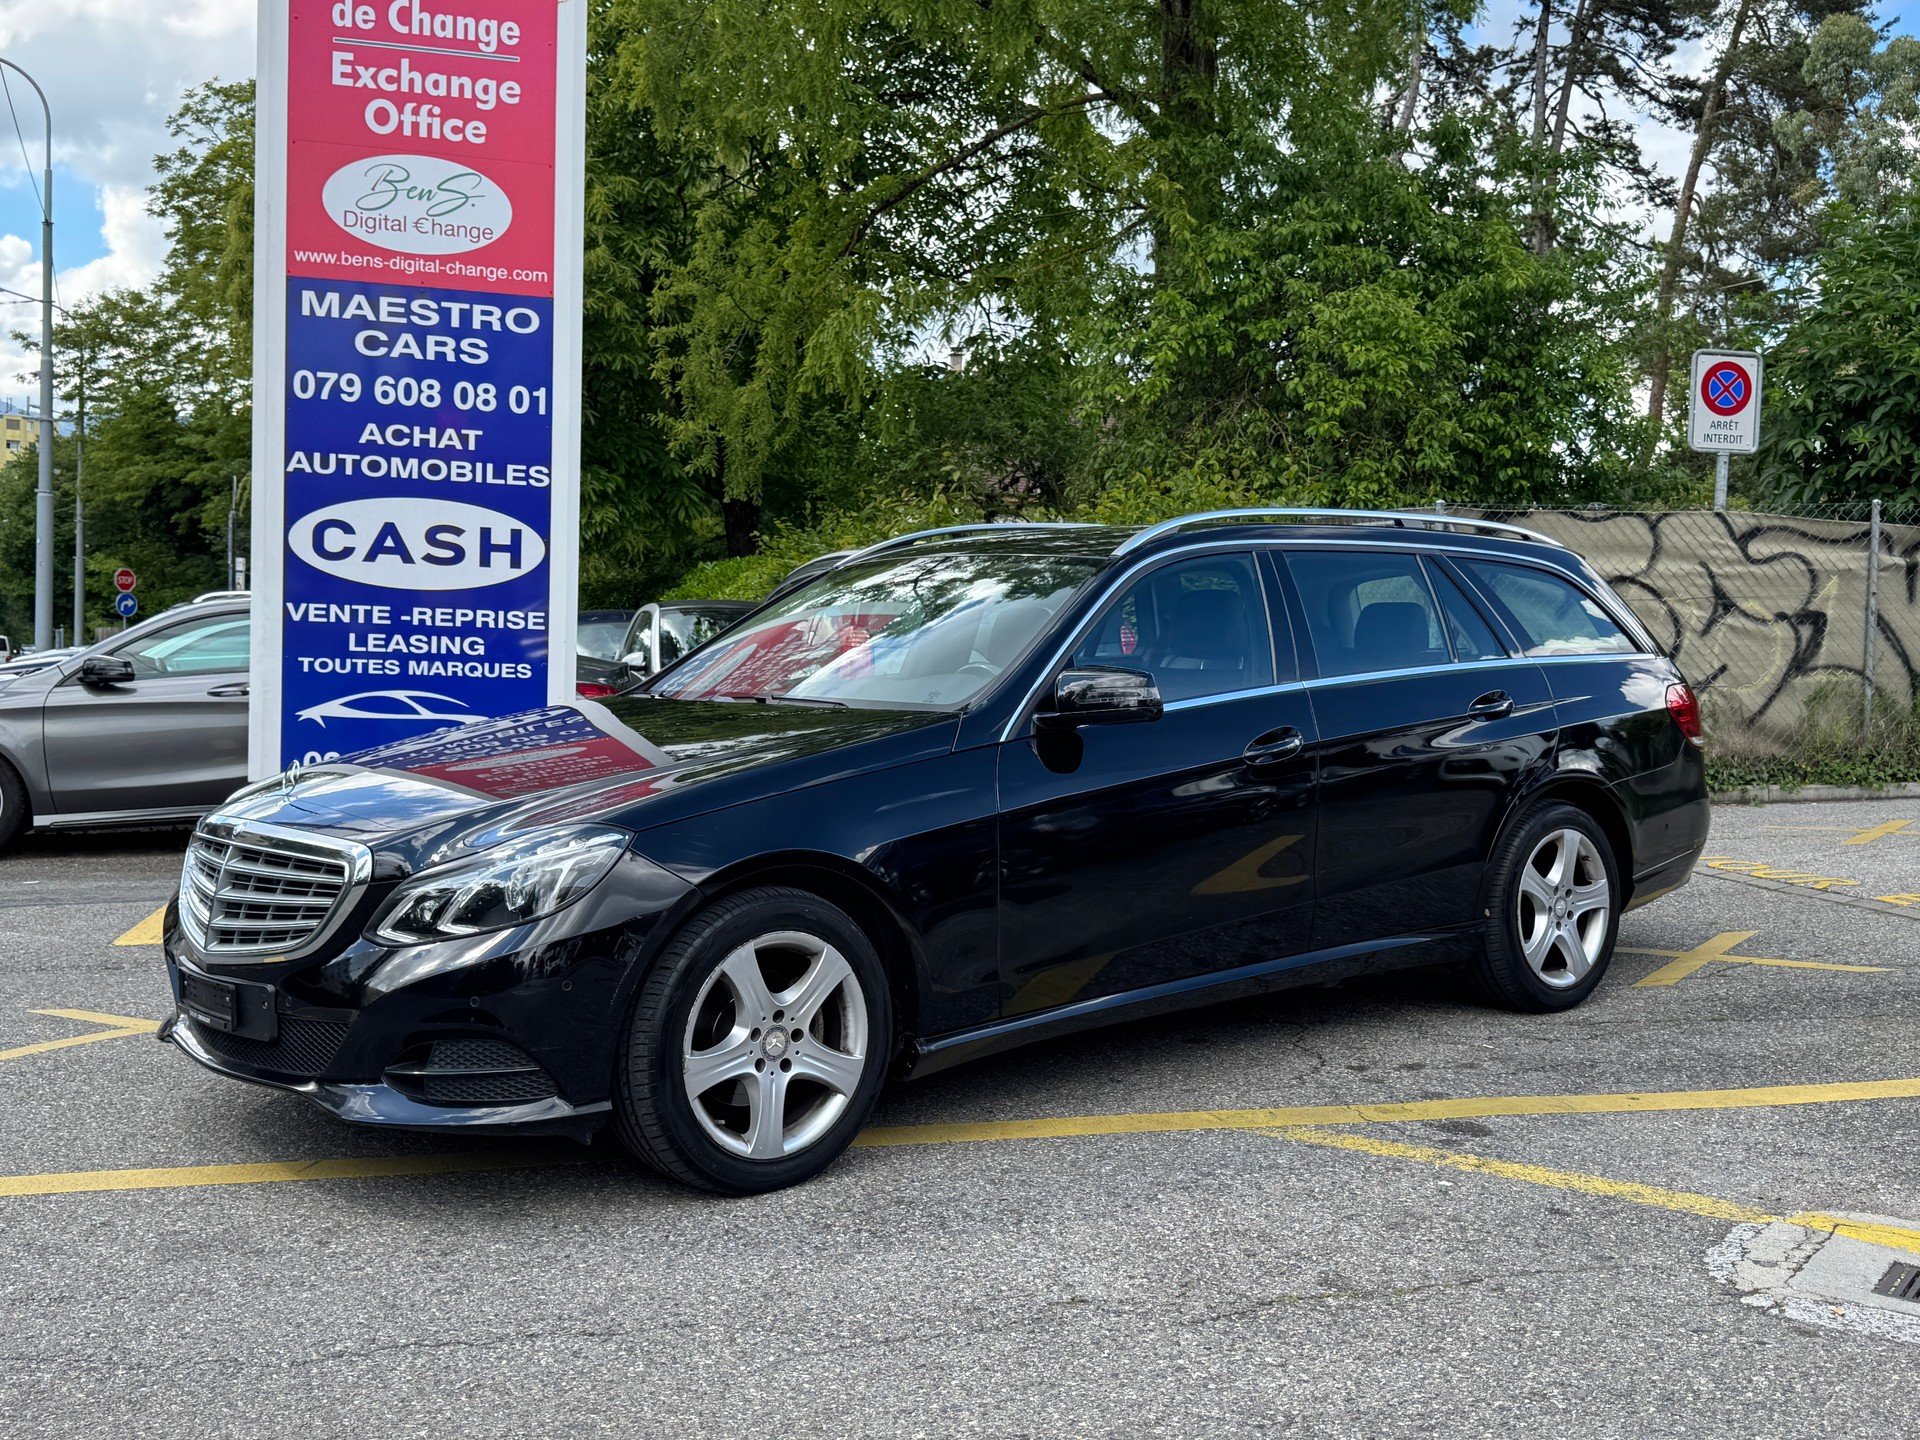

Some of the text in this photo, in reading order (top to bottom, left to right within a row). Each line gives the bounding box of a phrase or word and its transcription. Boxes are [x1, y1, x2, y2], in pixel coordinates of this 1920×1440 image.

[332, 0, 521, 53] de Change
[331, 51, 521, 111] Exchange
[364, 98, 487, 144] Office
[343, 209, 407, 234] Digital
[294, 250, 548, 283] www.bens-digital-change.com
[301, 290, 540, 334] MAESTRO
[354, 330, 490, 365] CARS
[293, 369, 547, 416] 079 608 08 01
[358, 422, 483, 451] ACHAT
[1703, 433, 1744, 444] INTERDIT
[1709, 419, 1739, 431] ARRÊT
[286, 450, 550, 488] AUTOMOBILES
[311, 517, 523, 570] CASH
[117, 576, 134, 585] STOP
[285, 602, 391, 625] VENTE
[348, 632, 486, 656] LEASING
[297, 656, 533, 679] TOUTES MARQUES
